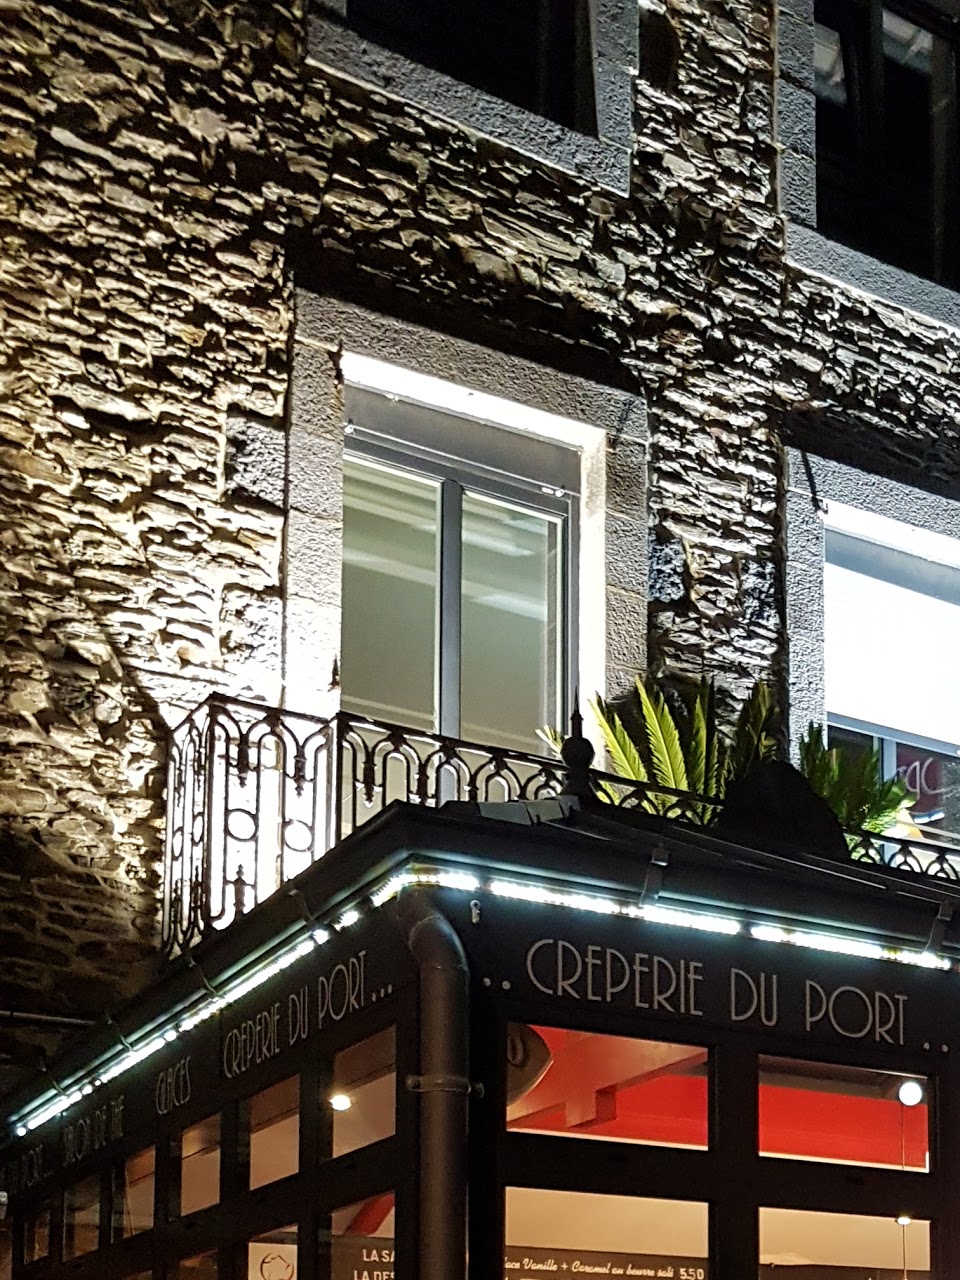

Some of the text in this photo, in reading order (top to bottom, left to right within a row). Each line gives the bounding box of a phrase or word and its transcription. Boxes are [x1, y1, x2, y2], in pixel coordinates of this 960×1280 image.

[526, 938, 703, 1016] CREPERIE
[730, 967, 779, 1027] DU
[223, 1001, 282, 1079] CREPERIE
[288, 988, 310, 1046] DU
